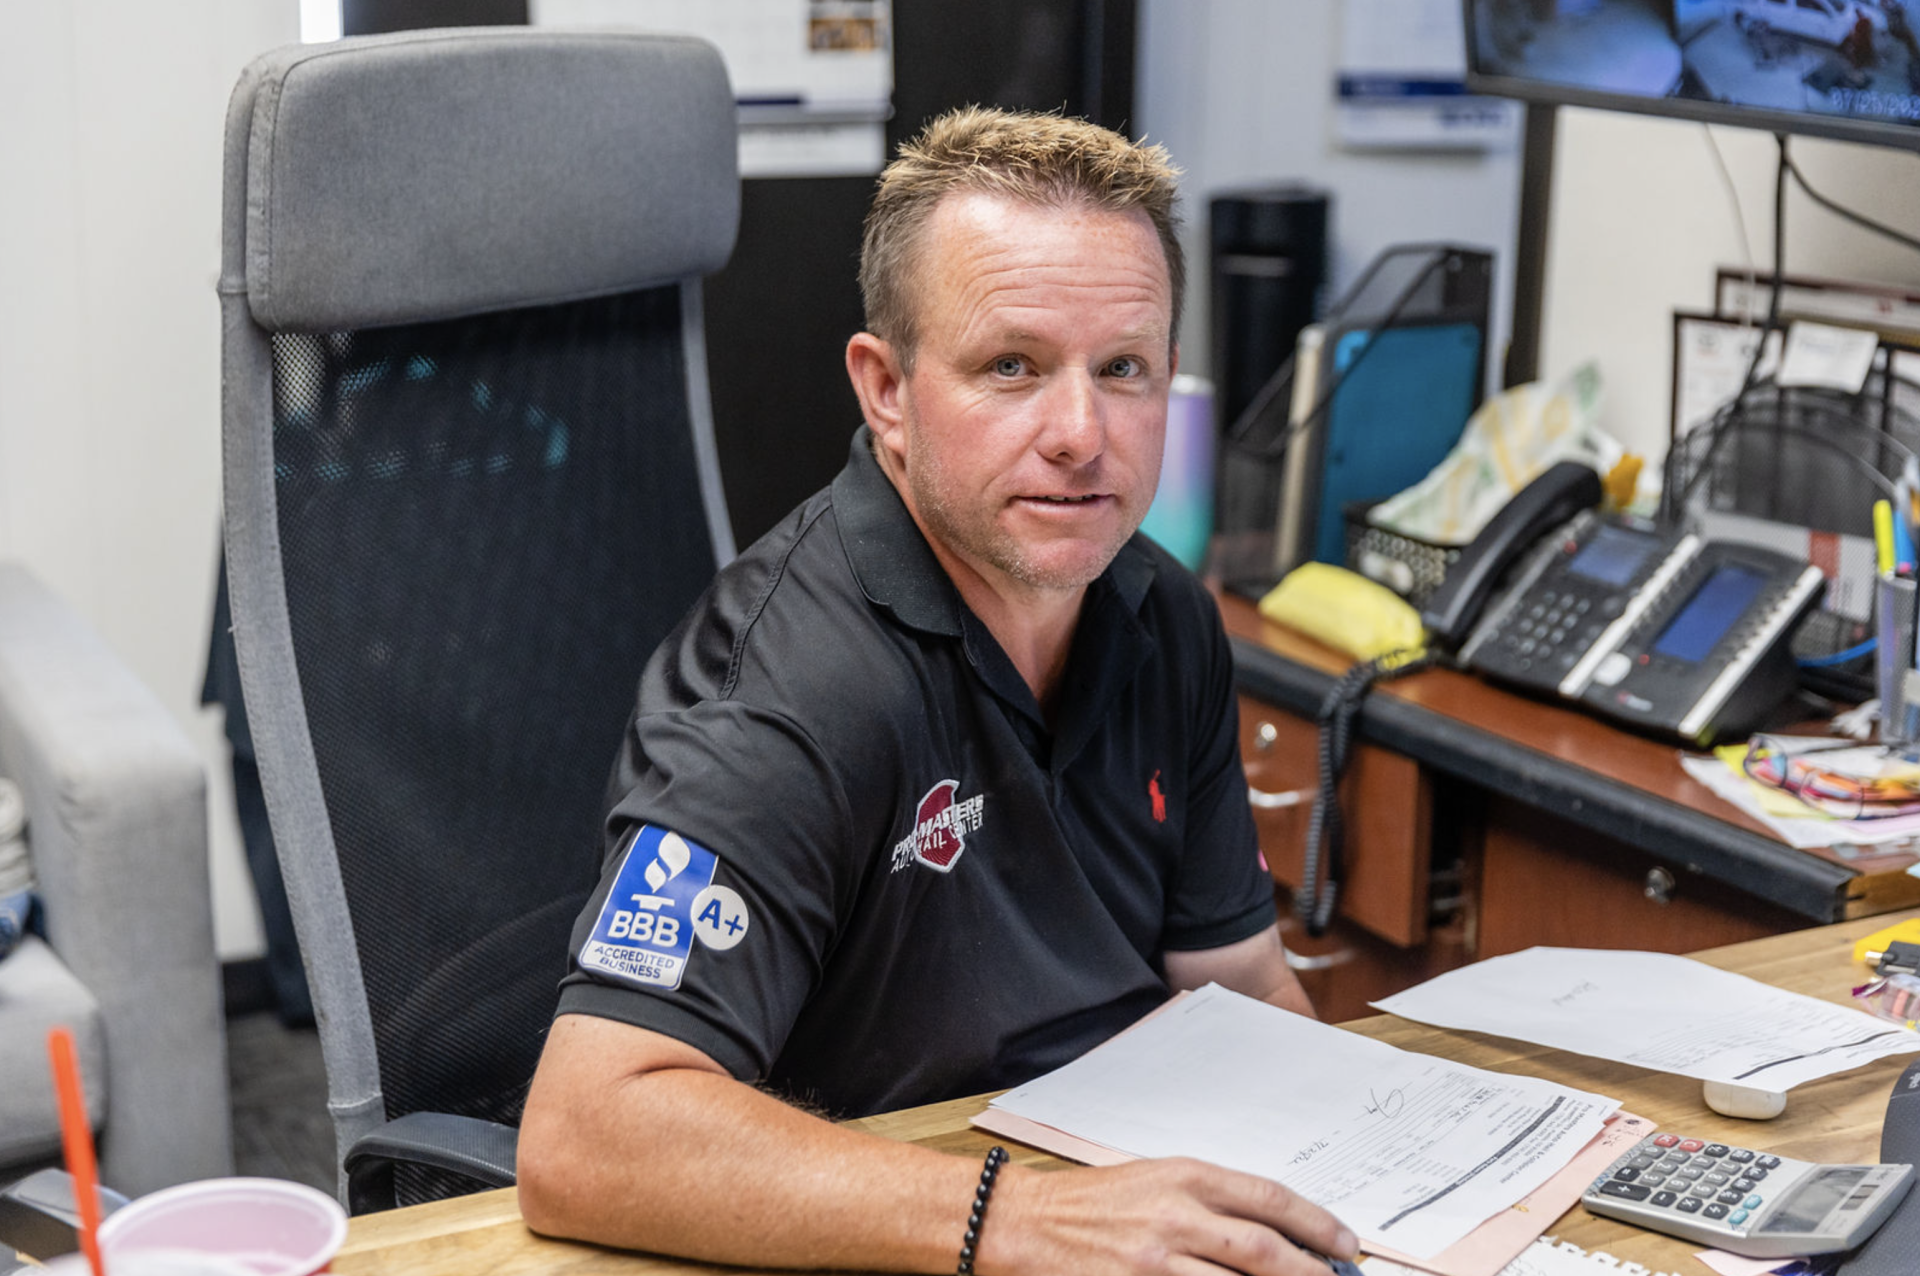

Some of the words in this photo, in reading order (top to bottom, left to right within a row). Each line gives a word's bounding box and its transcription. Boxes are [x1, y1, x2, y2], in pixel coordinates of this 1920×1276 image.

[607, 910, 680, 948] BBB
[697, 898, 744, 936] A+
[594, 946, 675, 969] ACCREDITED
[598, 956, 662, 979] BUSINESS
